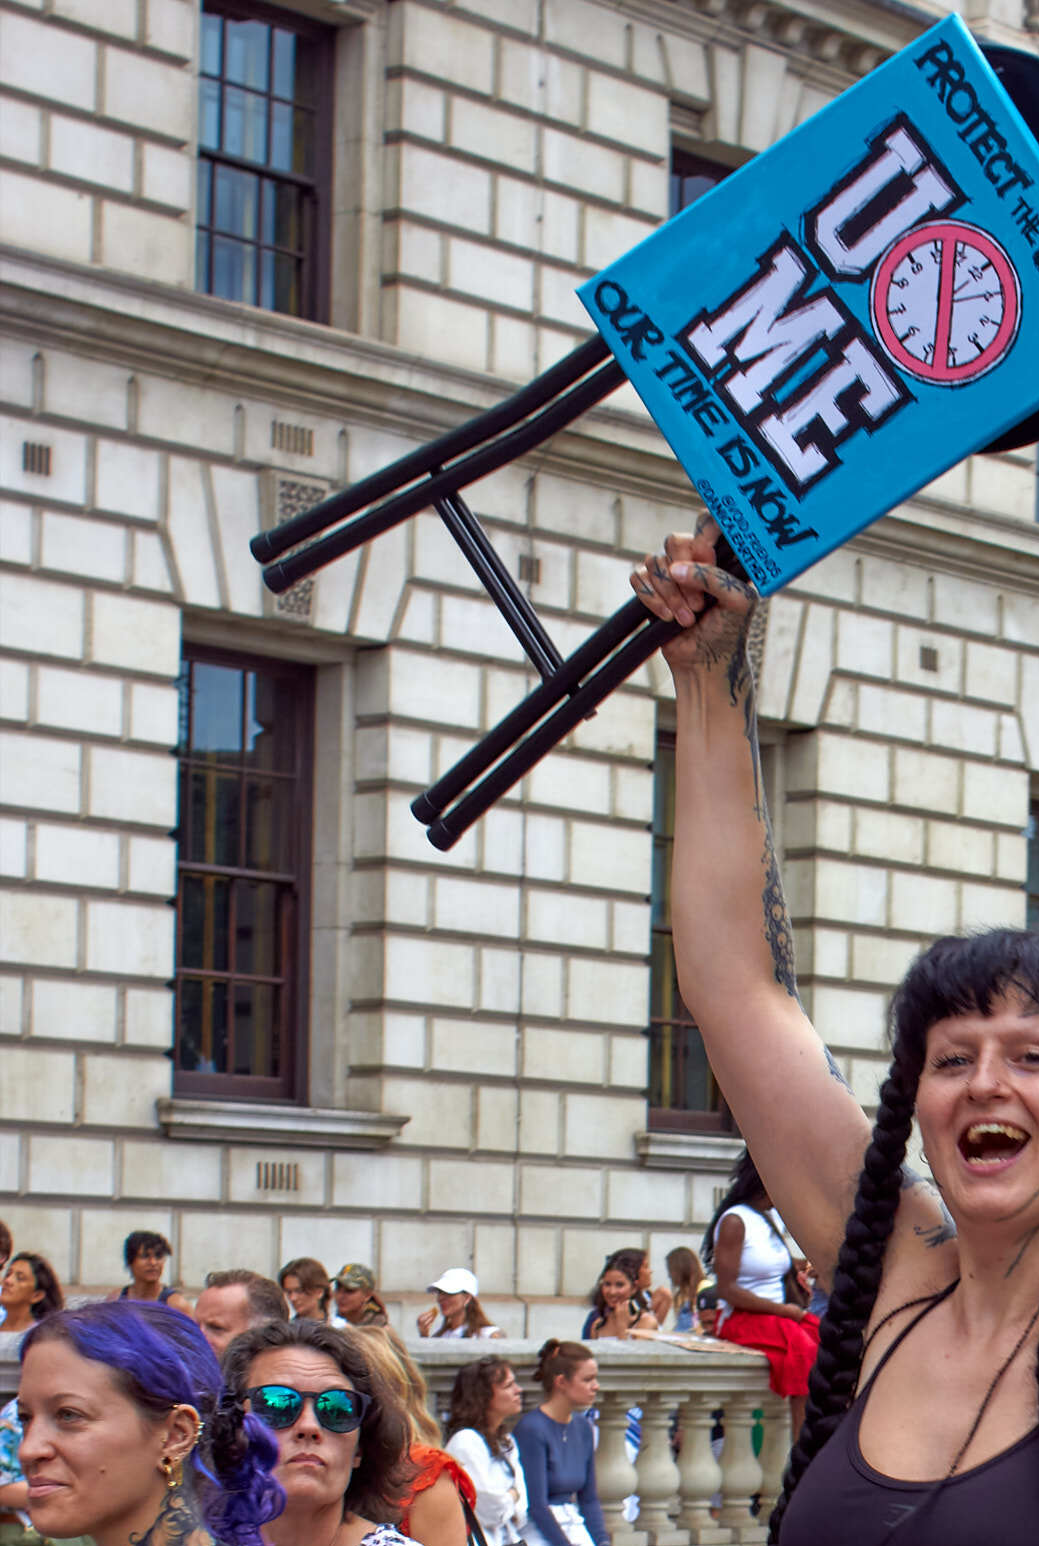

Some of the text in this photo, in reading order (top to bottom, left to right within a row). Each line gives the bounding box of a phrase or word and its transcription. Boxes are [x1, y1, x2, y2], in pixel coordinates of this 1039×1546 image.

[802, 112, 970, 284] U
[913, 38, 1035, 199] PROTECT
[594, 280, 820, 551] OUR TIME IS NOW
[674, 225, 916, 500] ME
